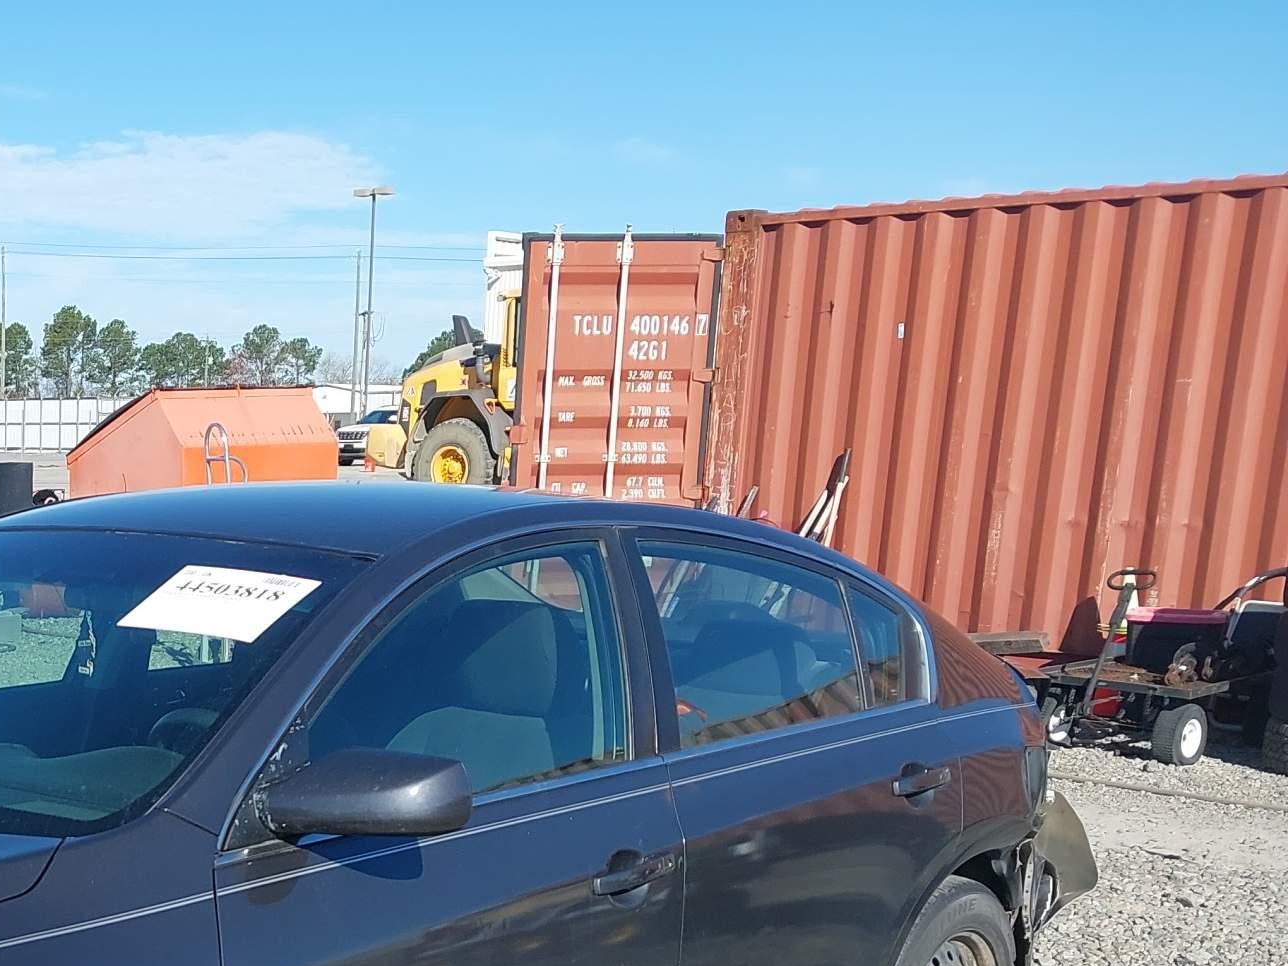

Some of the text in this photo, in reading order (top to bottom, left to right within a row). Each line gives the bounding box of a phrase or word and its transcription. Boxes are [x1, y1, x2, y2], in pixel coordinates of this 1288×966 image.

[573, 315, 708, 336] TCLU 400146 7
[628, 340, 667, 360] 42G1
[583, 376, 605, 387] GROSS
[558, 411, 575, 422] TARE
[176, 580, 285, 601] 44503818
